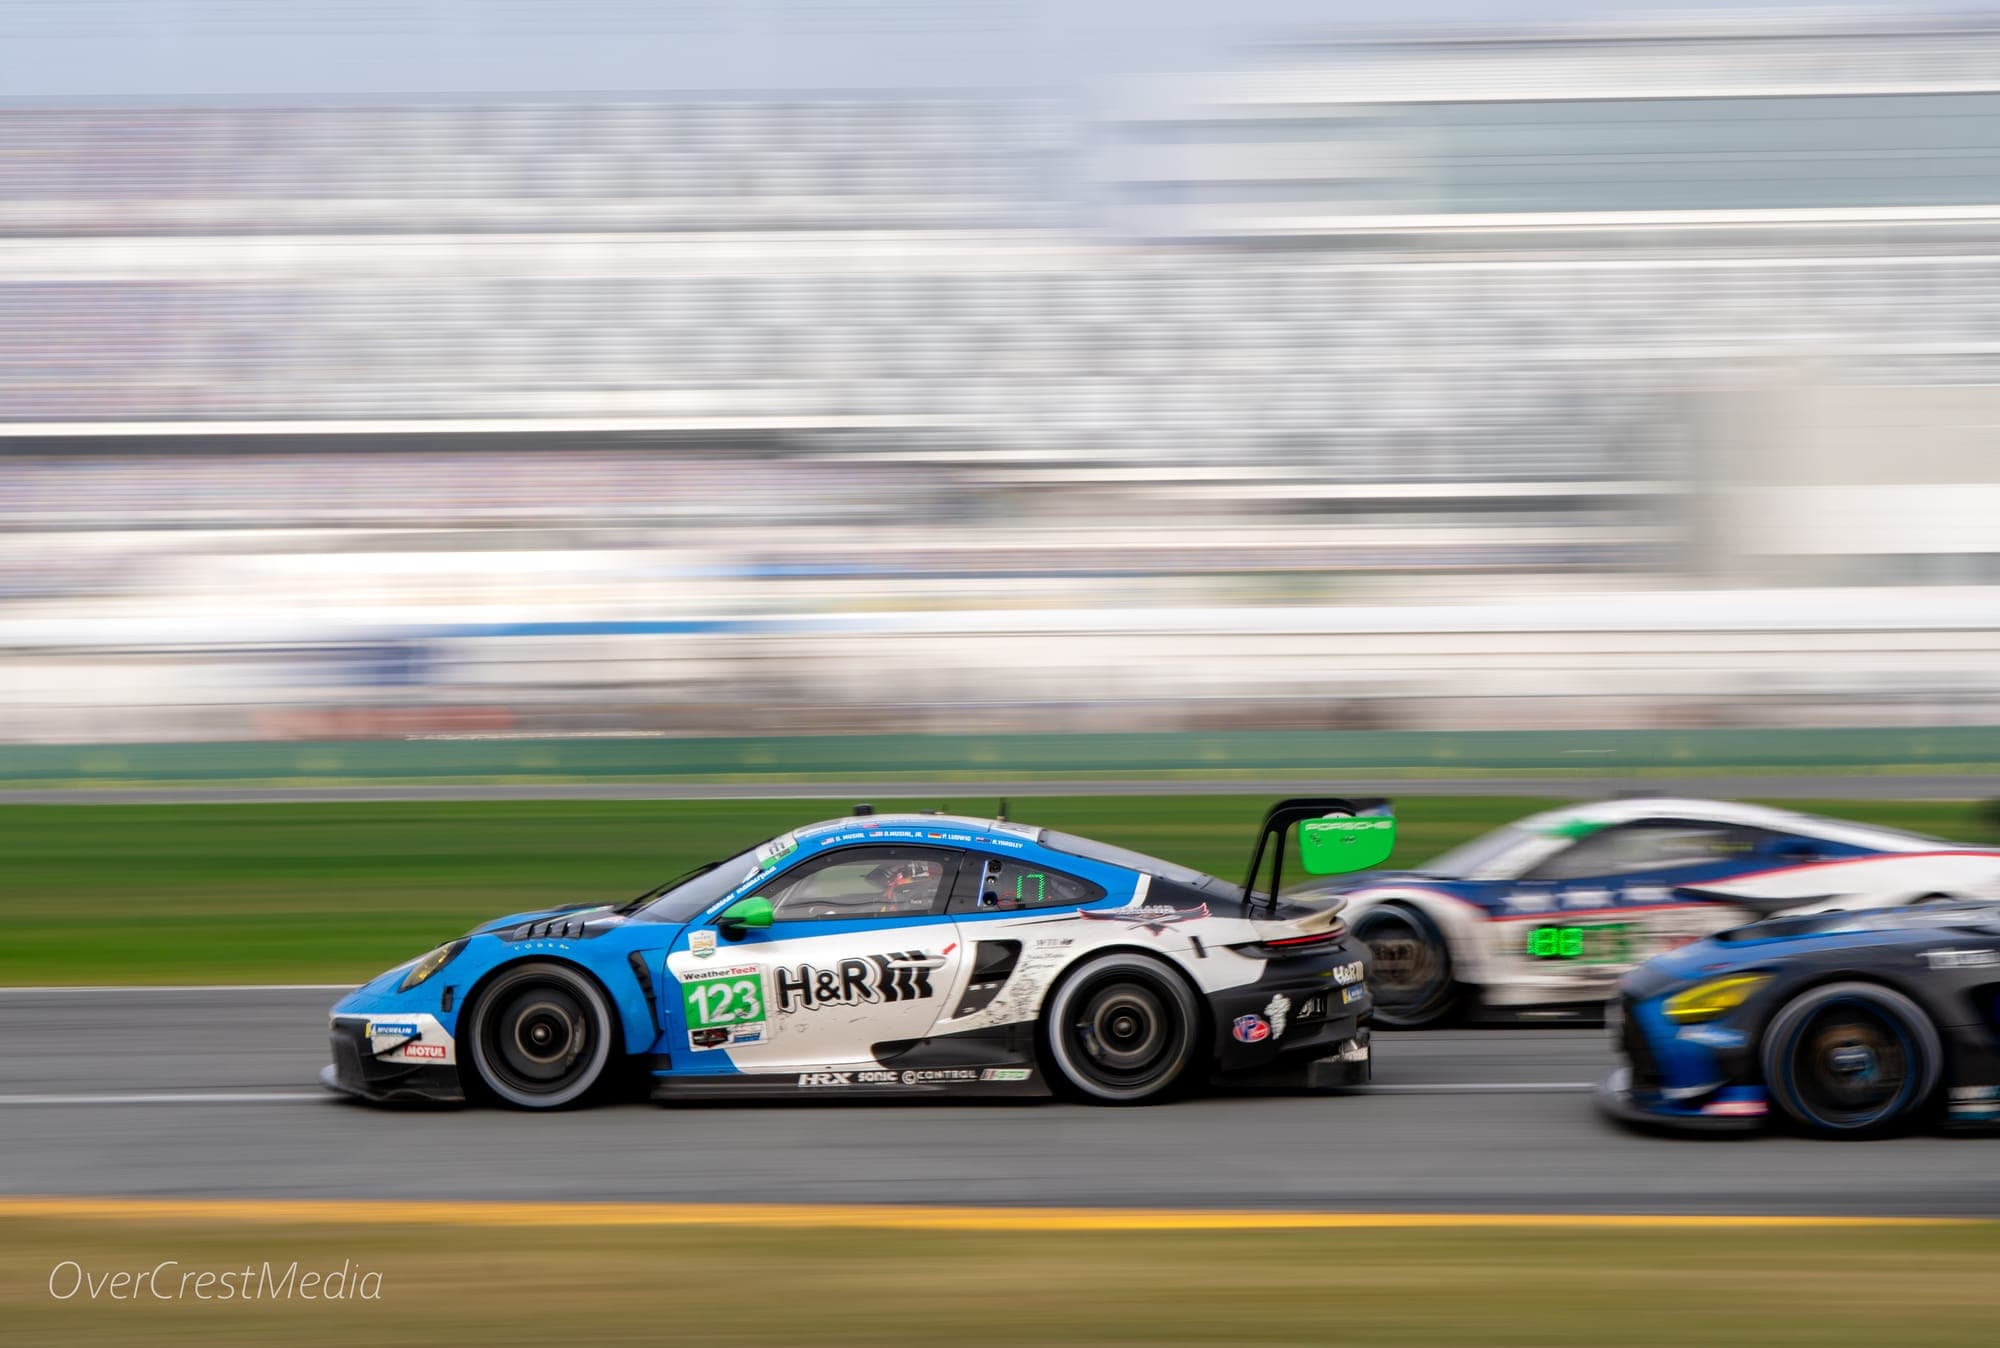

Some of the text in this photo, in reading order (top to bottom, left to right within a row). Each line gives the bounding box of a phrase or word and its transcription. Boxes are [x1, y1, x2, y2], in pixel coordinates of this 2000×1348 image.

[684, 966, 757, 980] WeatherTech
[776, 959, 876, 1010] H&R
[688, 980, 760, 1024] 123
[406, 1046, 444, 1057] MOTUL
[798, 1072, 853, 1087] HRX
